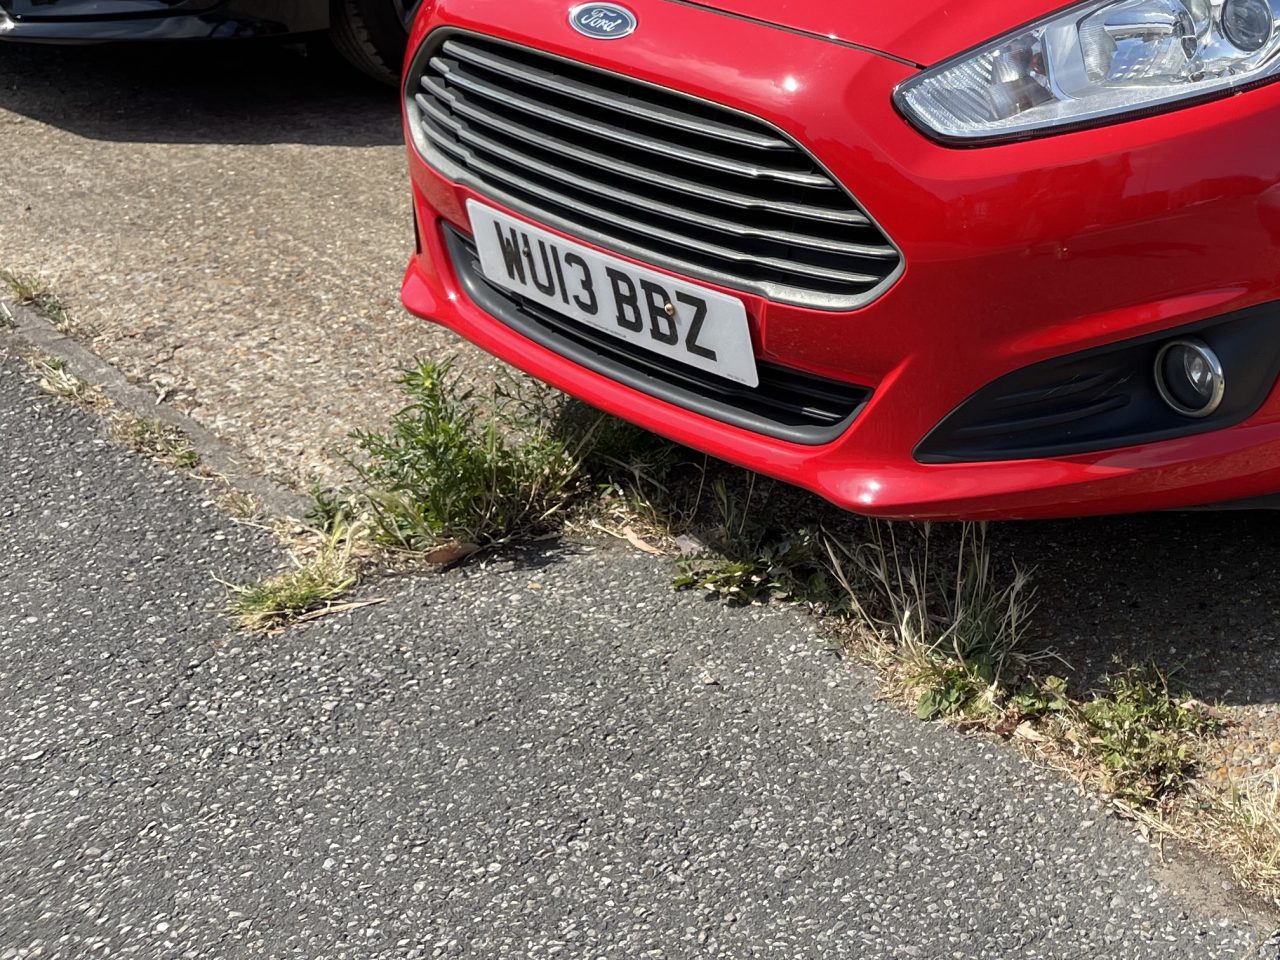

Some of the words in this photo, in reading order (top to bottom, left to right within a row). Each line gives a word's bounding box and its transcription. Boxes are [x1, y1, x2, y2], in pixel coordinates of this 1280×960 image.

[581, 8, 622, 31] Ford
[493, 220, 599, 316] WU13
[605, 265, 717, 362] BBZ
